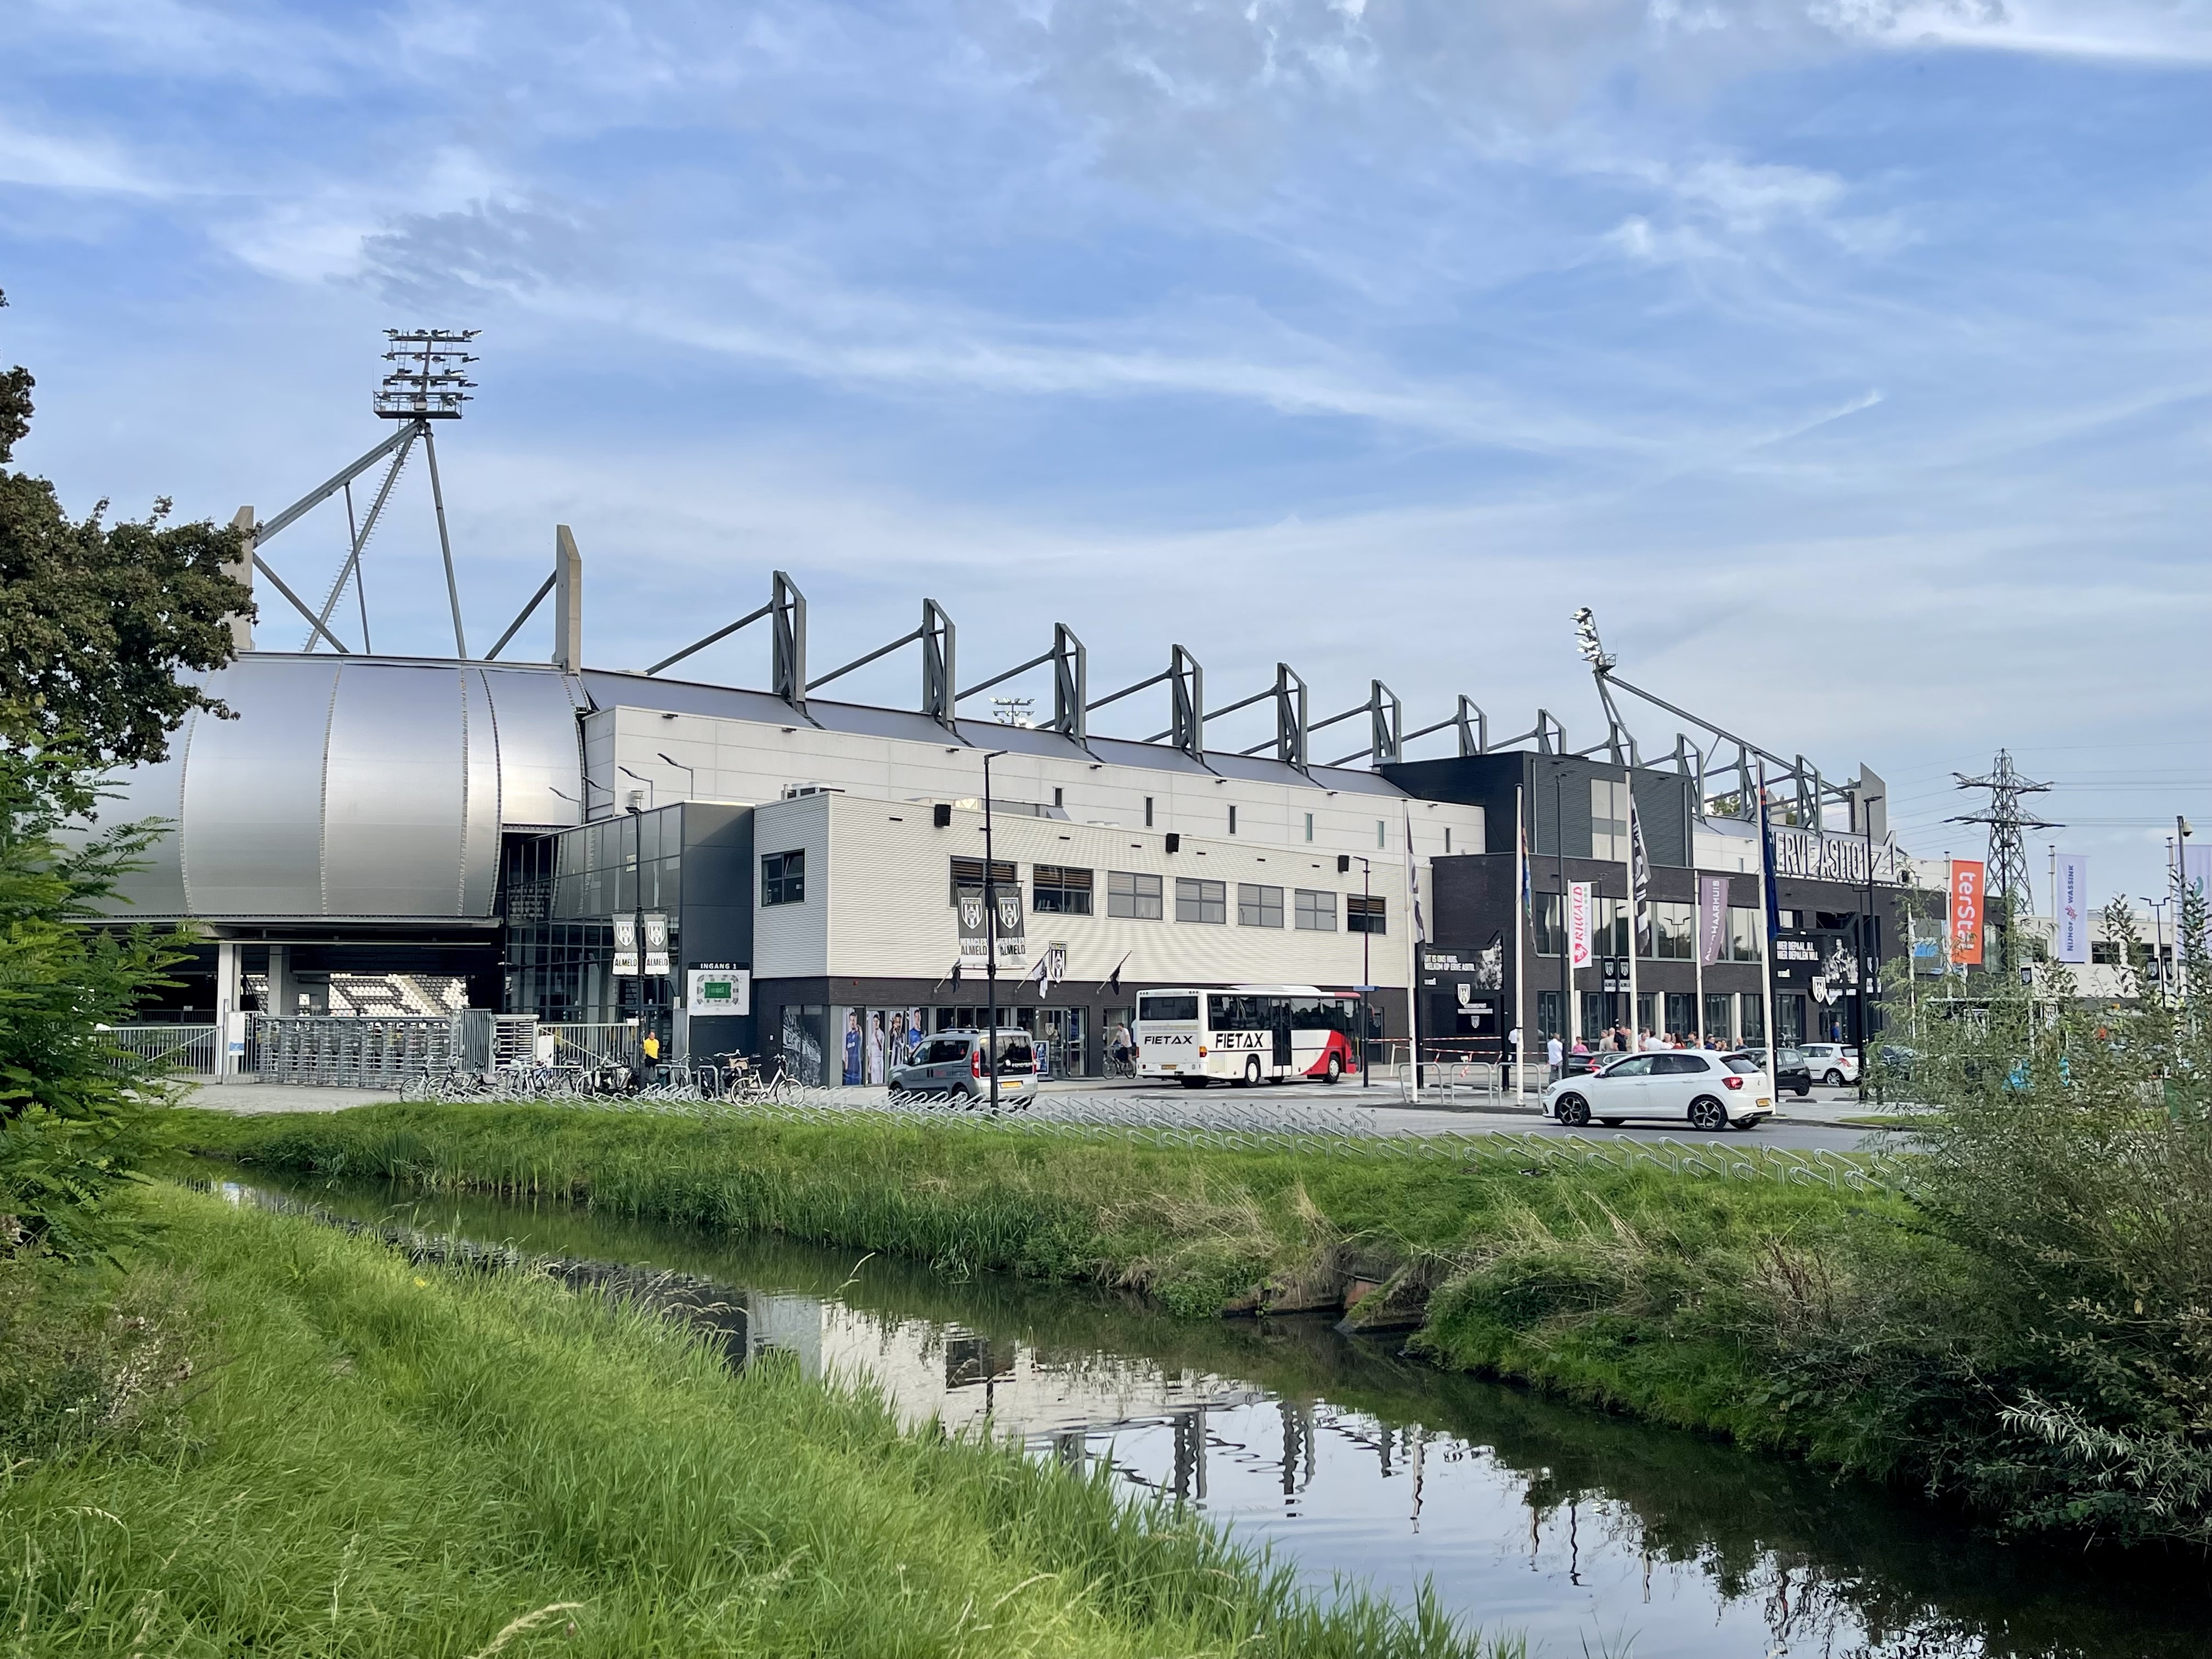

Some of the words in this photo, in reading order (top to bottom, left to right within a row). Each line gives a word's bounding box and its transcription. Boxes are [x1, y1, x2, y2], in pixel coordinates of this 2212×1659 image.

[1774, 832, 1815, 874] ERVE
[1819, 838, 1861, 879] ASITO
[1573, 887, 1583, 941] RIWALD
[1705, 880, 1720, 962] AHAARHUIS
[961, 946, 988, 955] ALMELO
[1000, 945, 1026, 956] ALMELO
[614, 958, 637, 967] ALMELO
[646, 958, 668, 966] ALMELO
[1144, 1035, 1193, 1045] FIETAX
[1215, 1032, 1264, 1048] FIETAX
